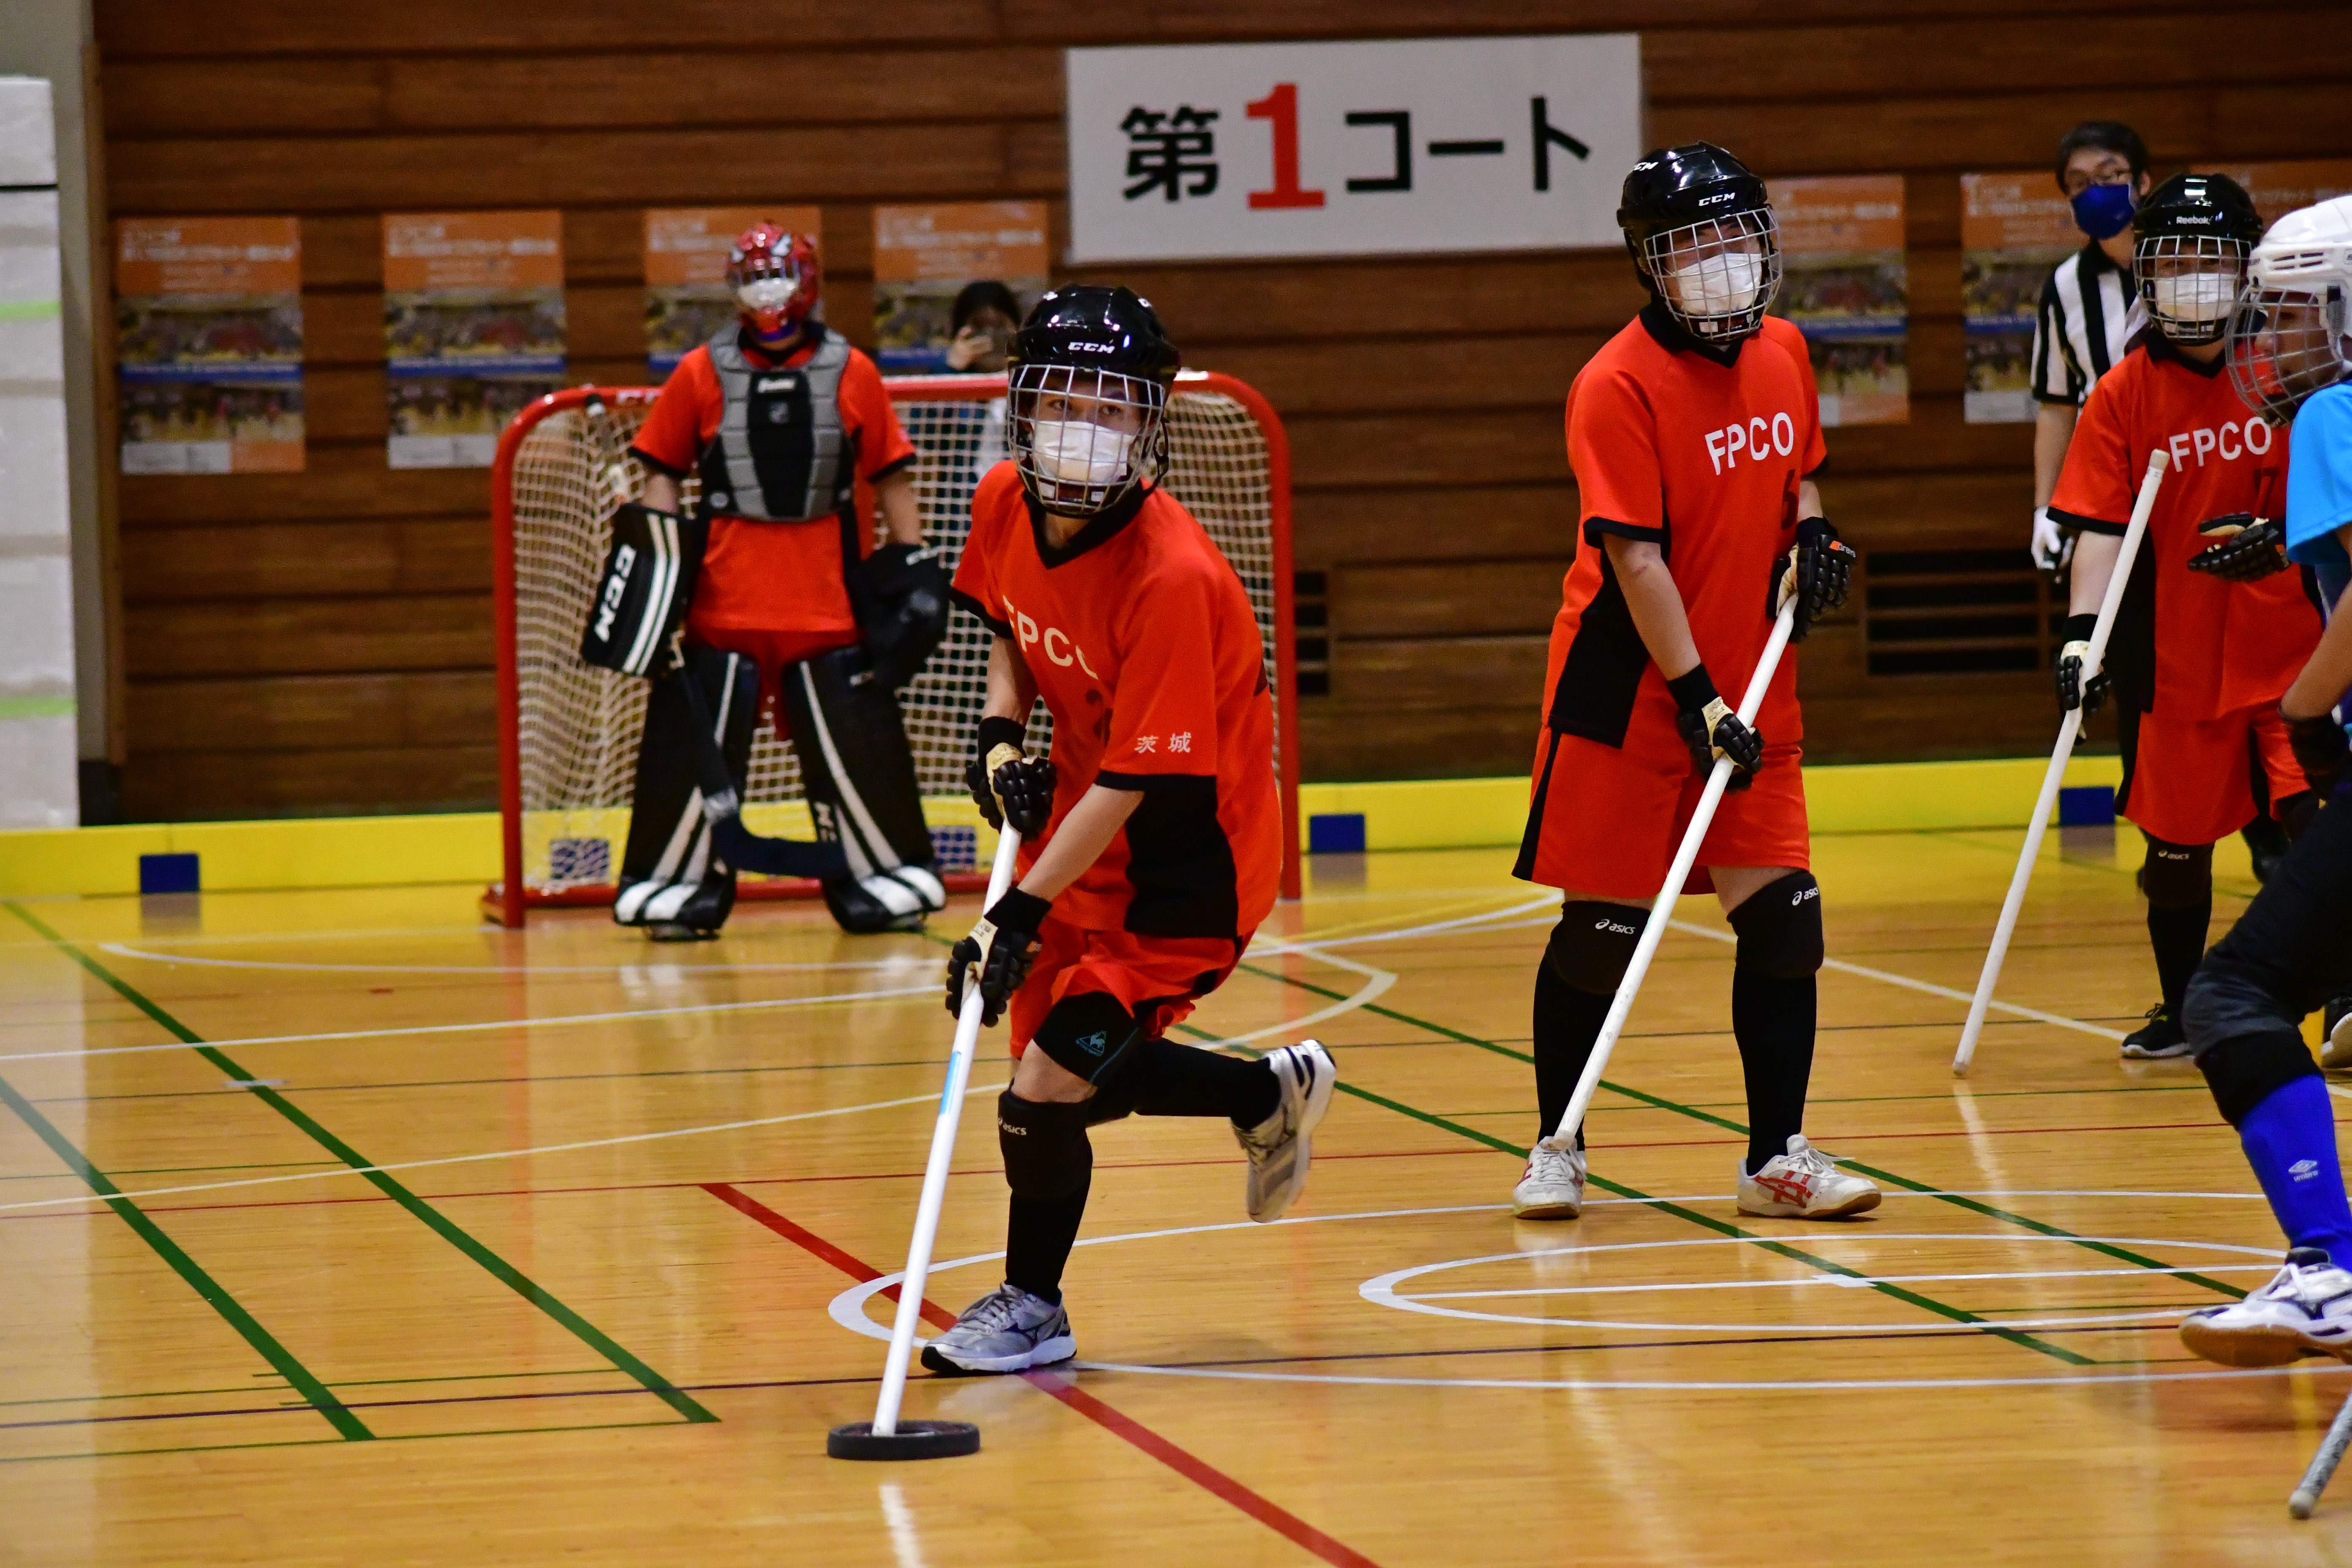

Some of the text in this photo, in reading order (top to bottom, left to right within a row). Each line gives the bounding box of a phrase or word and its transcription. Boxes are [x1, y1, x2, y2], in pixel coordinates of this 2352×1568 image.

[1119, 82, 1590, 211] 第1コート
[1633, 161, 1659, 171] CM
[1699, 192, 1735, 206] CCM
[2176, 215, 2210, 225] Reebok
[1068, 342, 1115, 354] CCM
[1705, 412, 1794, 476] FPCO
[2169, 416, 2271, 472] FPCO
[1781, 469, 1798, 529] 6
[2253, 466, 2279, 517] 7
[594, 544, 637, 642] CCM
[1135, 731, 1192, 754] 茨城
[1609, 923, 1636, 934] asics
[1003, 1122, 1026, 1135] asics
[2293, 1170, 2318, 1181] umbro
